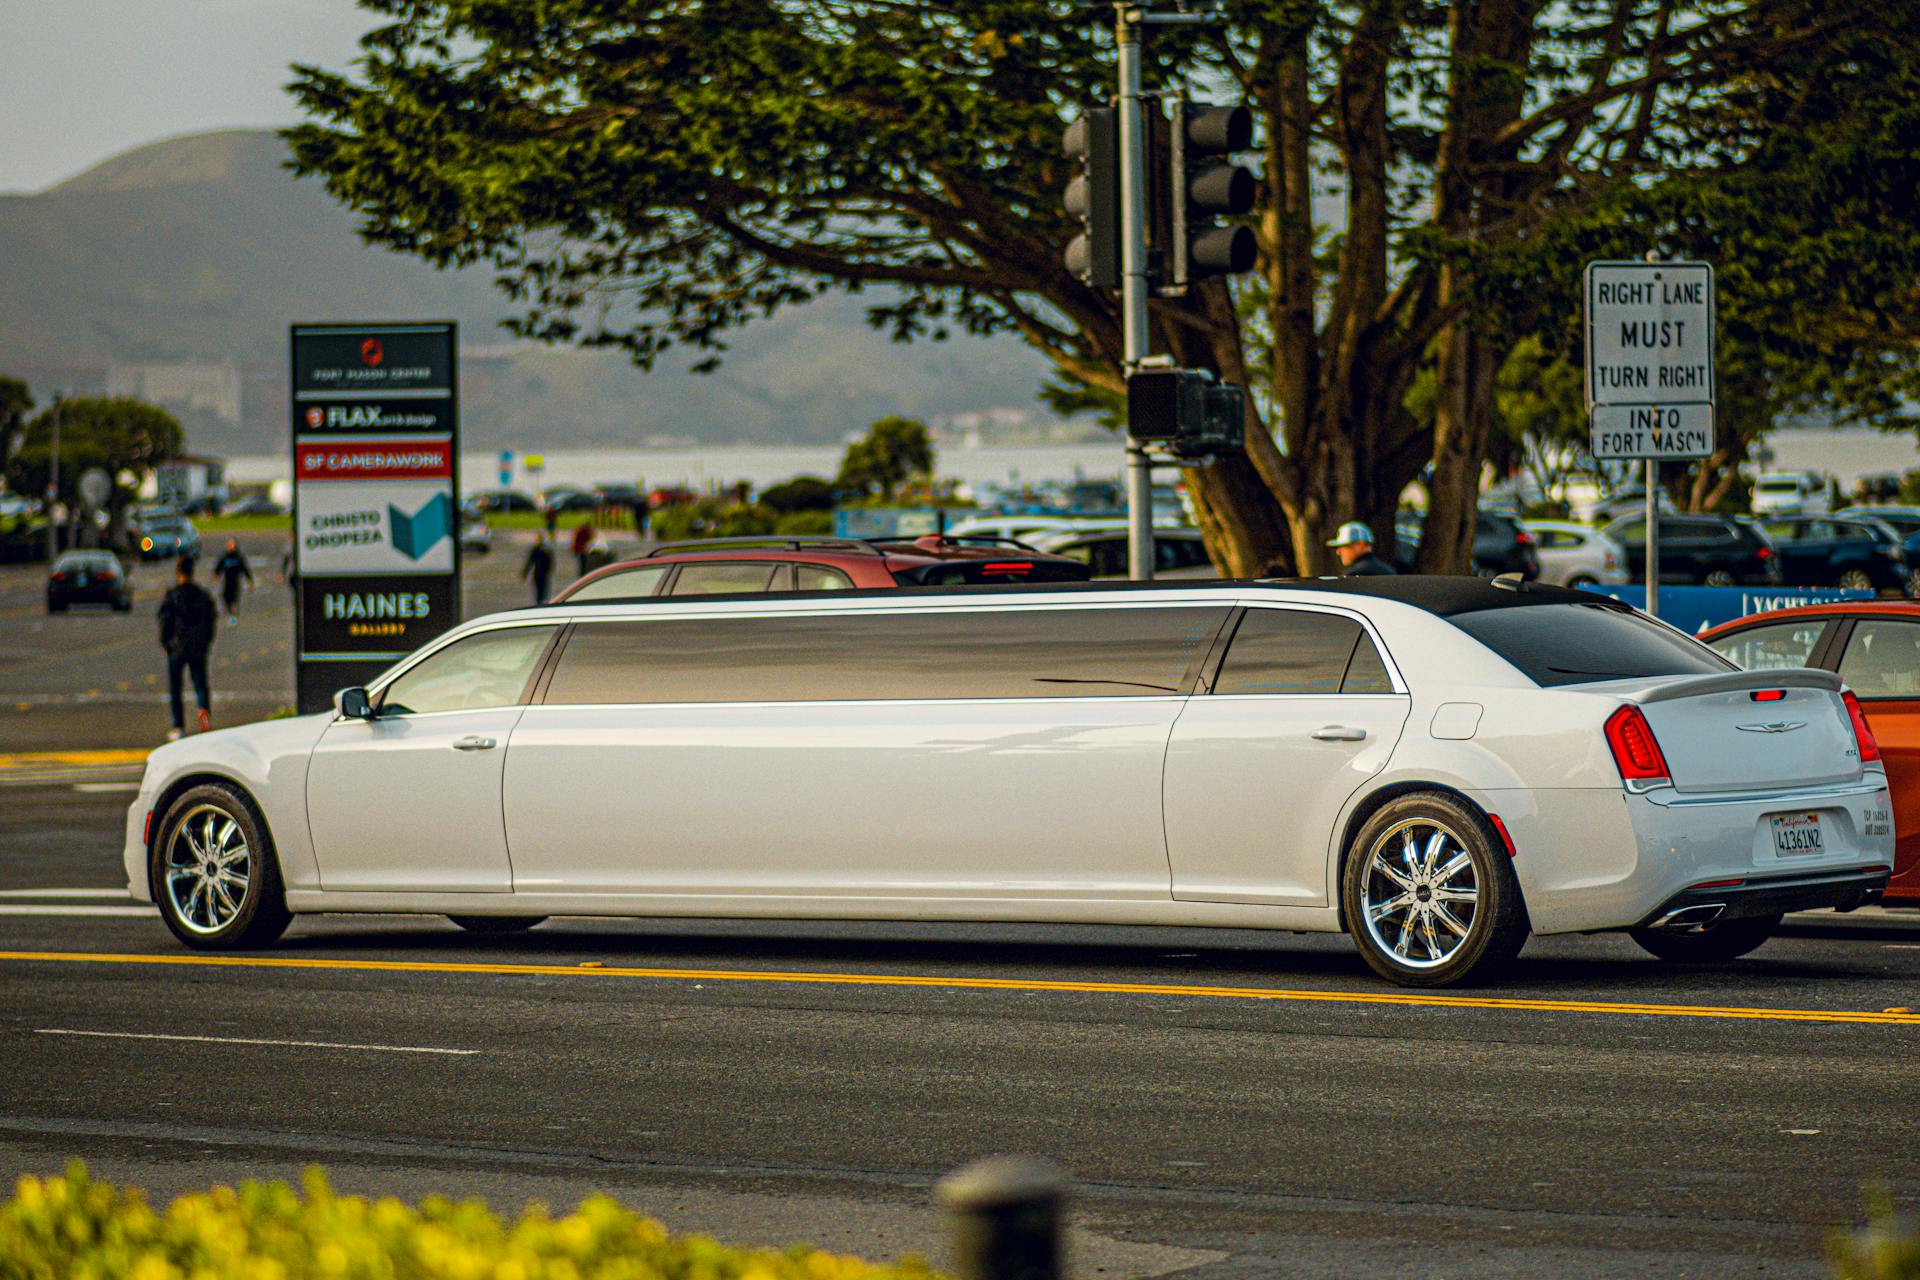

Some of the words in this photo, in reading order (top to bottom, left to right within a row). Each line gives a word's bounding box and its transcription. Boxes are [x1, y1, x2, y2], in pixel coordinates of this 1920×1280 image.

[1600, 283, 1654, 305] RIGHT
[1664, 283, 1703, 305] LANE
[1621, 322, 1685, 348] MUST
[1599, 366, 1648, 388] TURN
[1659, 366, 1705, 388] RIGHT
[328, 406, 383, 427] FLAX
[1630, 409, 1680, 429] INTO
[1602, 433, 1643, 453] FORT
[305, 455, 324, 469] SF
[327, 453, 443, 468] CAMERAWORK
[312, 511, 380, 530] CHRISTO
[305, 531, 383, 549] OROPEZA
[324, 593, 430, 619] HAINES
